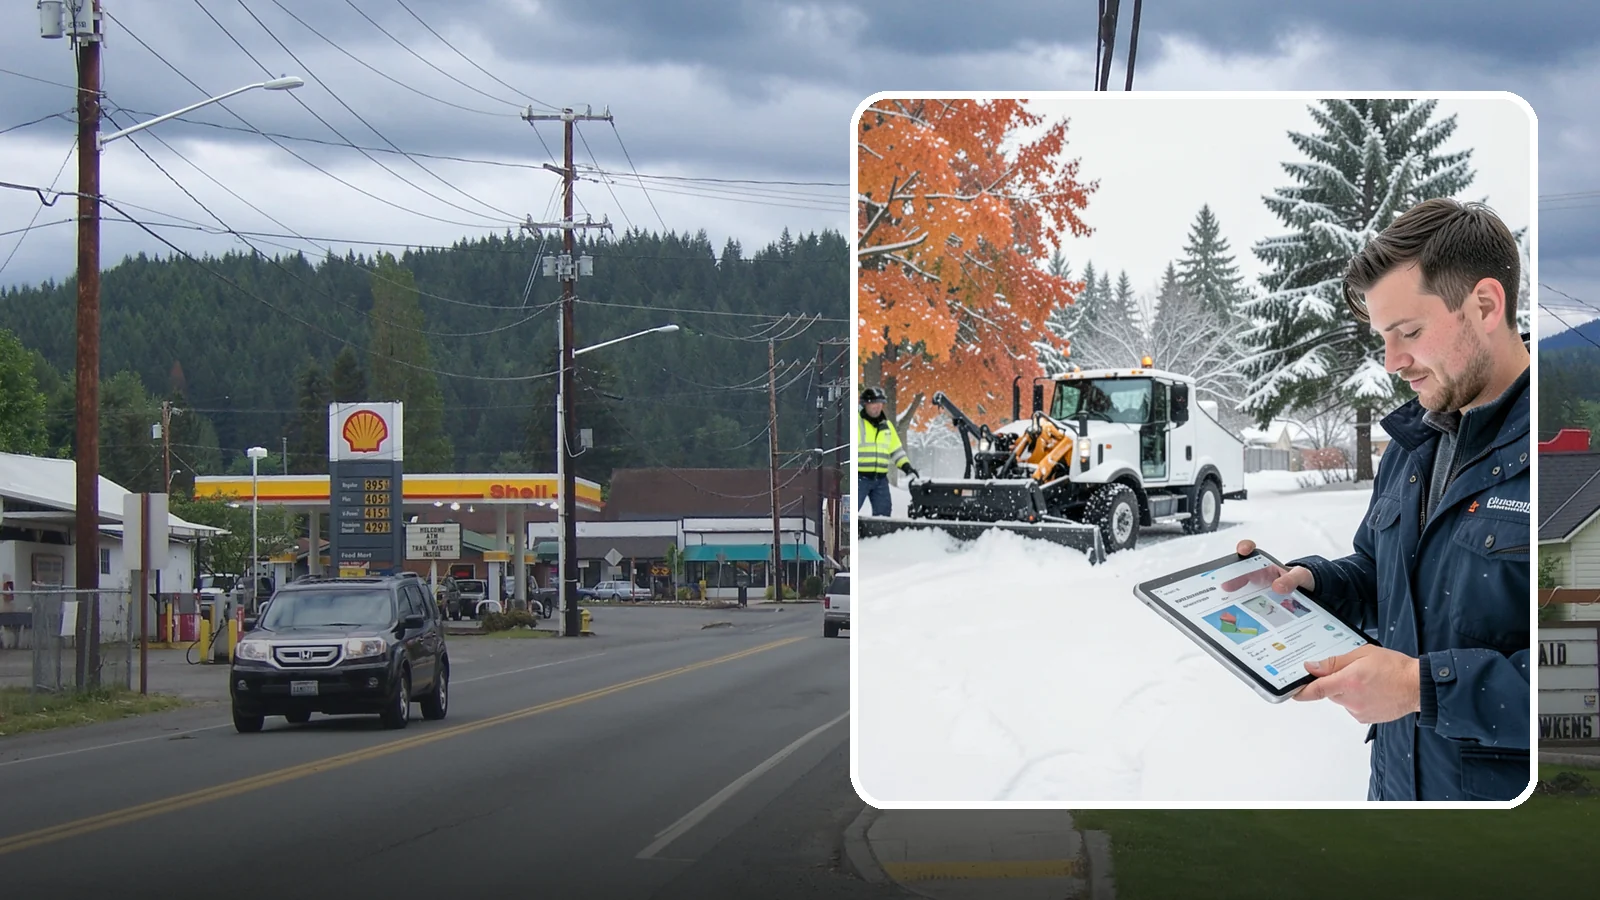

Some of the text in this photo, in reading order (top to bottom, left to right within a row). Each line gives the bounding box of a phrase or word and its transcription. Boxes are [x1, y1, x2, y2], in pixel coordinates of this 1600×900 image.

[366, 480, 383, 490] 395
[490, 484, 547, 499] Shell
[366, 494, 383, 504] 405
[366, 508, 383, 518] 415
[366, 522, 383, 532] 429
